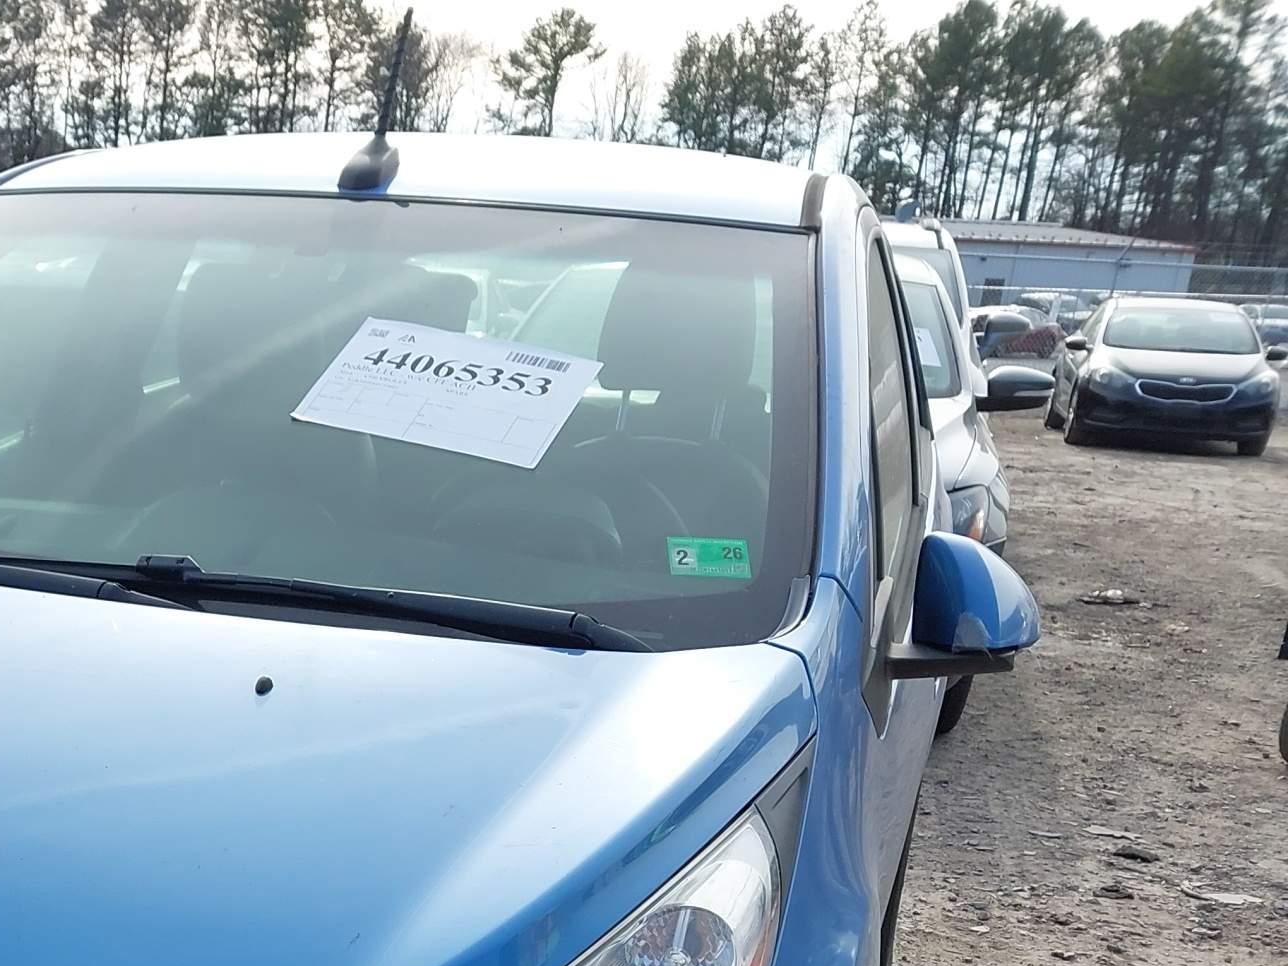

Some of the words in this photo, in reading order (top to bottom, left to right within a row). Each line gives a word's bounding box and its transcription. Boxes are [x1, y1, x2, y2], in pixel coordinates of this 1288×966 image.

[363, 347, 553, 397] 44065353
[676, 549, 690, 566] 2
[722, 546, 743, 560] 26
